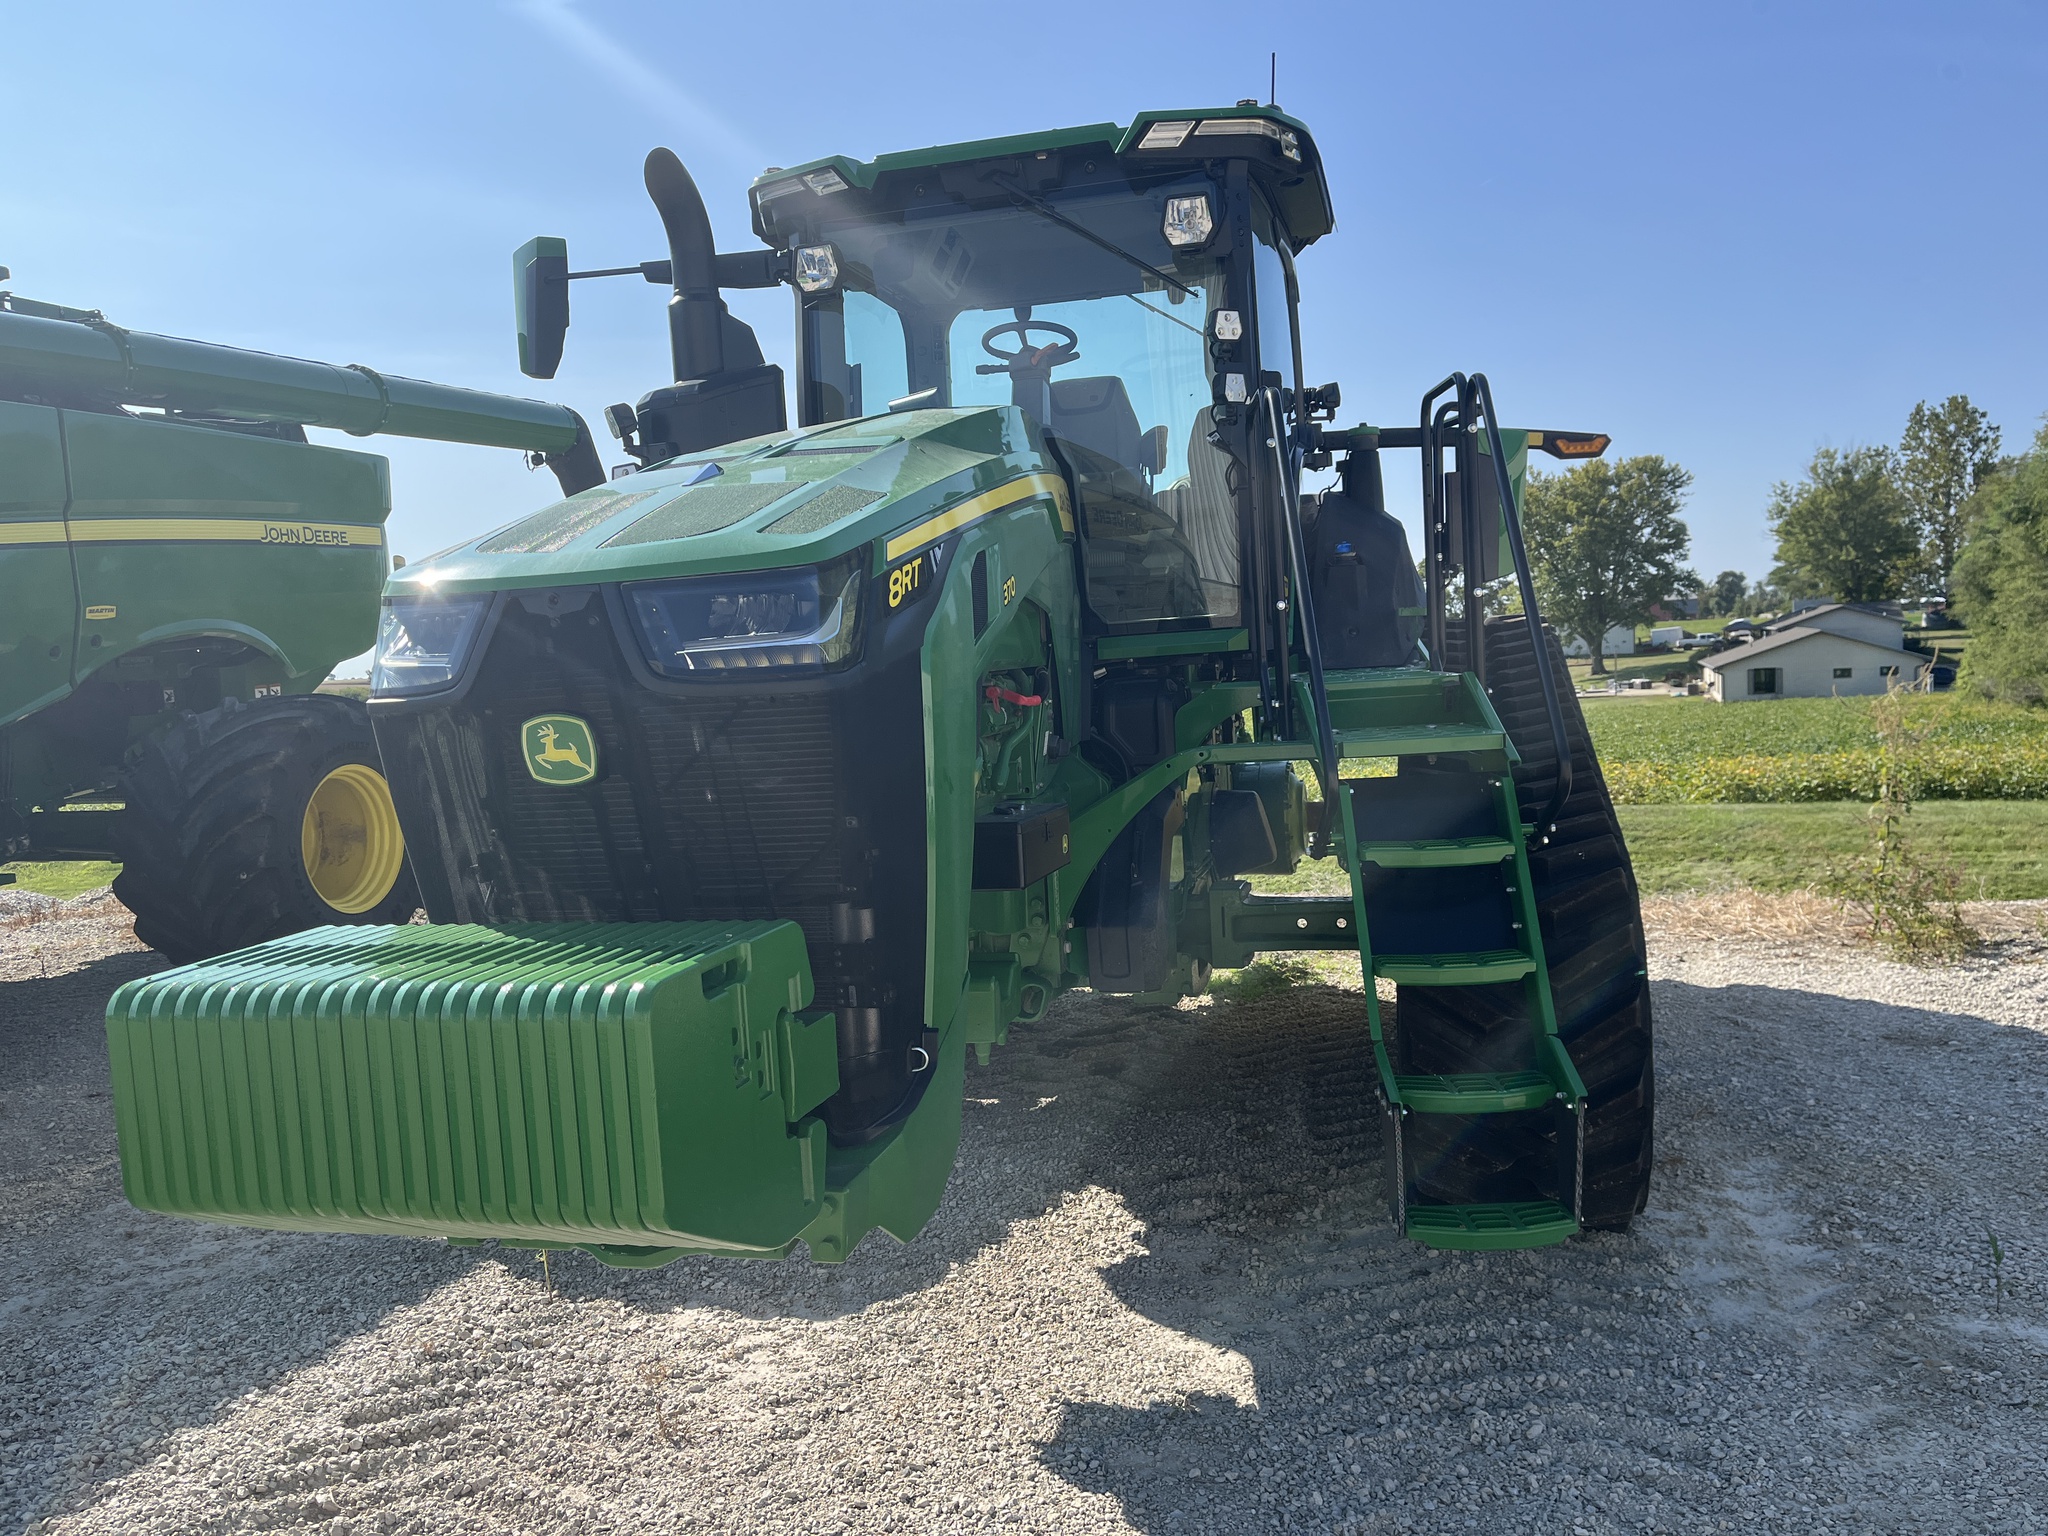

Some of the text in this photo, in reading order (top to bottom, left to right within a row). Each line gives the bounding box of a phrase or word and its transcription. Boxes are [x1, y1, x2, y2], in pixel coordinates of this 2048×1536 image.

[260, 524, 348, 544] JOHN DEERE
[888, 557, 922, 608] 8RT
[1003, 575, 1016, 606] 370
